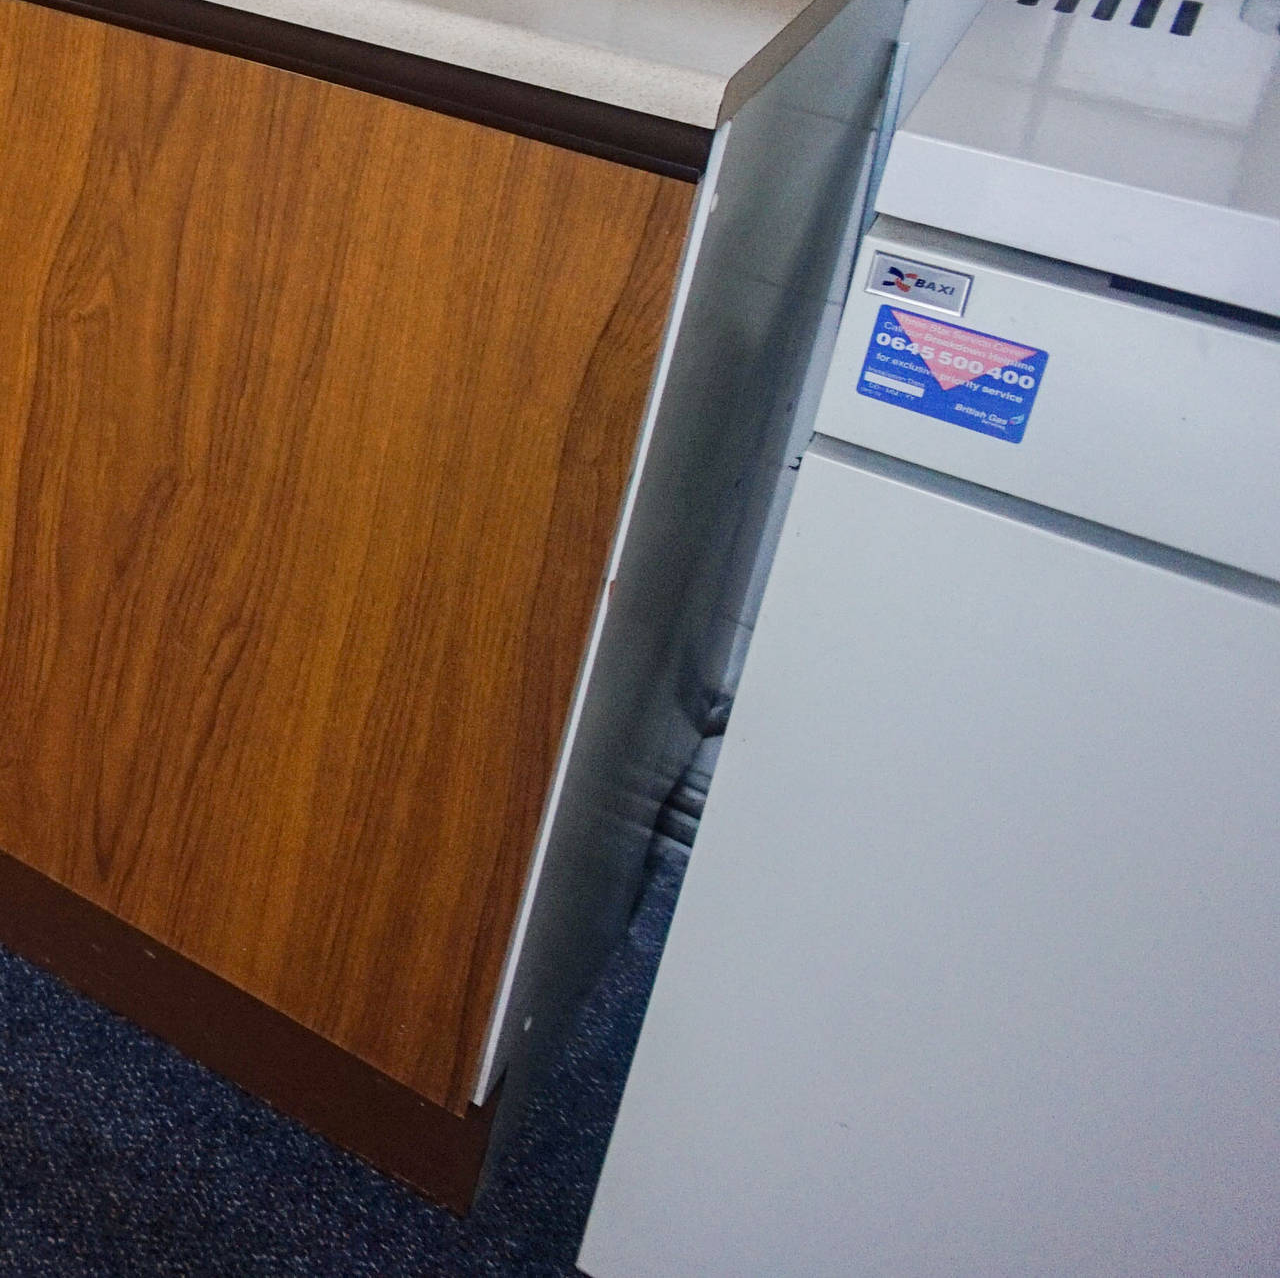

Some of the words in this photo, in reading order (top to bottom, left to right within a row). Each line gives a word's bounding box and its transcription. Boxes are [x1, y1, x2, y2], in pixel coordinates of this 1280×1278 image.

[914, 278, 955, 296] BAXI
[875, 332, 935, 360] 0645
[937, 350, 984, 375] 500
[985, 366, 1036, 390] 400
[875, 352, 891, 363] for
[981, 385, 1024, 404] service
[954, 403, 987, 420] British
[988, 413, 1008, 426] Gas
